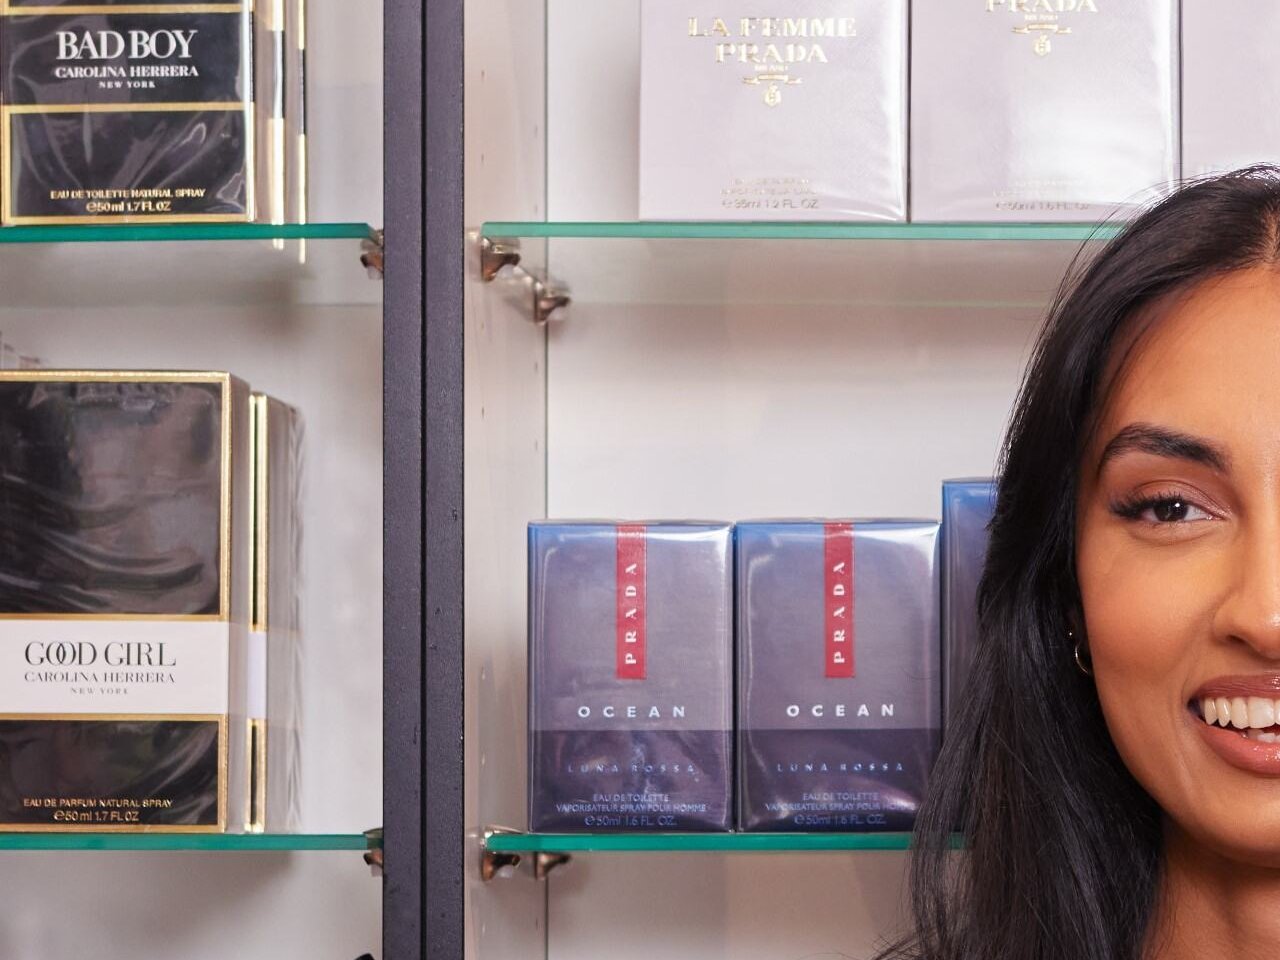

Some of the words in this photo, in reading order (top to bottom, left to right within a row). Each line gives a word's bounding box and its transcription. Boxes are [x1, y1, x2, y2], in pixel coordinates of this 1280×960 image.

[688, 17, 731, 37] LA
[740, 17, 857, 37] FEMME
[56, 30, 125, 60] BAD
[127, 29, 199, 59] BOY
[715, 43, 828, 63] PRADA
[55, 66, 127, 78] CAROLINA
[129, 65, 200, 77] HERRERA
[99, 81, 123, 89] NEW
[126, 80, 156, 89] YORK
[50, 190, 69, 200] EAU
[71, 190, 85, 200] DE
[86, 189, 129, 199] TOILETTE
[131, 189, 173, 199] NATURAL
[175, 188, 206, 198] SPRAY
[625, 563, 638, 665] PRADA
[833, 561, 846, 664] PRADA
[25, 641, 98, 667] GOOD
[104, 641, 177, 667] GIRL
[24, 671, 98, 683] CAROLINA
[104, 671, 175, 683] HERRERA
[71, 687, 94, 695] NEW
[577, 705, 686, 718] OCEAN
[786, 704, 895, 717] OCEAN
[568, 764, 619, 773] LUNA
[631, 764, 695, 774] ROSSA
[777, 763, 828, 772] LUNA
[24, 799, 42, 807] EAU
[44, 799, 57, 807] DE
[59, 799, 97, 807] PARFUM
[99, 799, 140, 807] NATURAL
[142, 799, 173, 807] SPRAY
